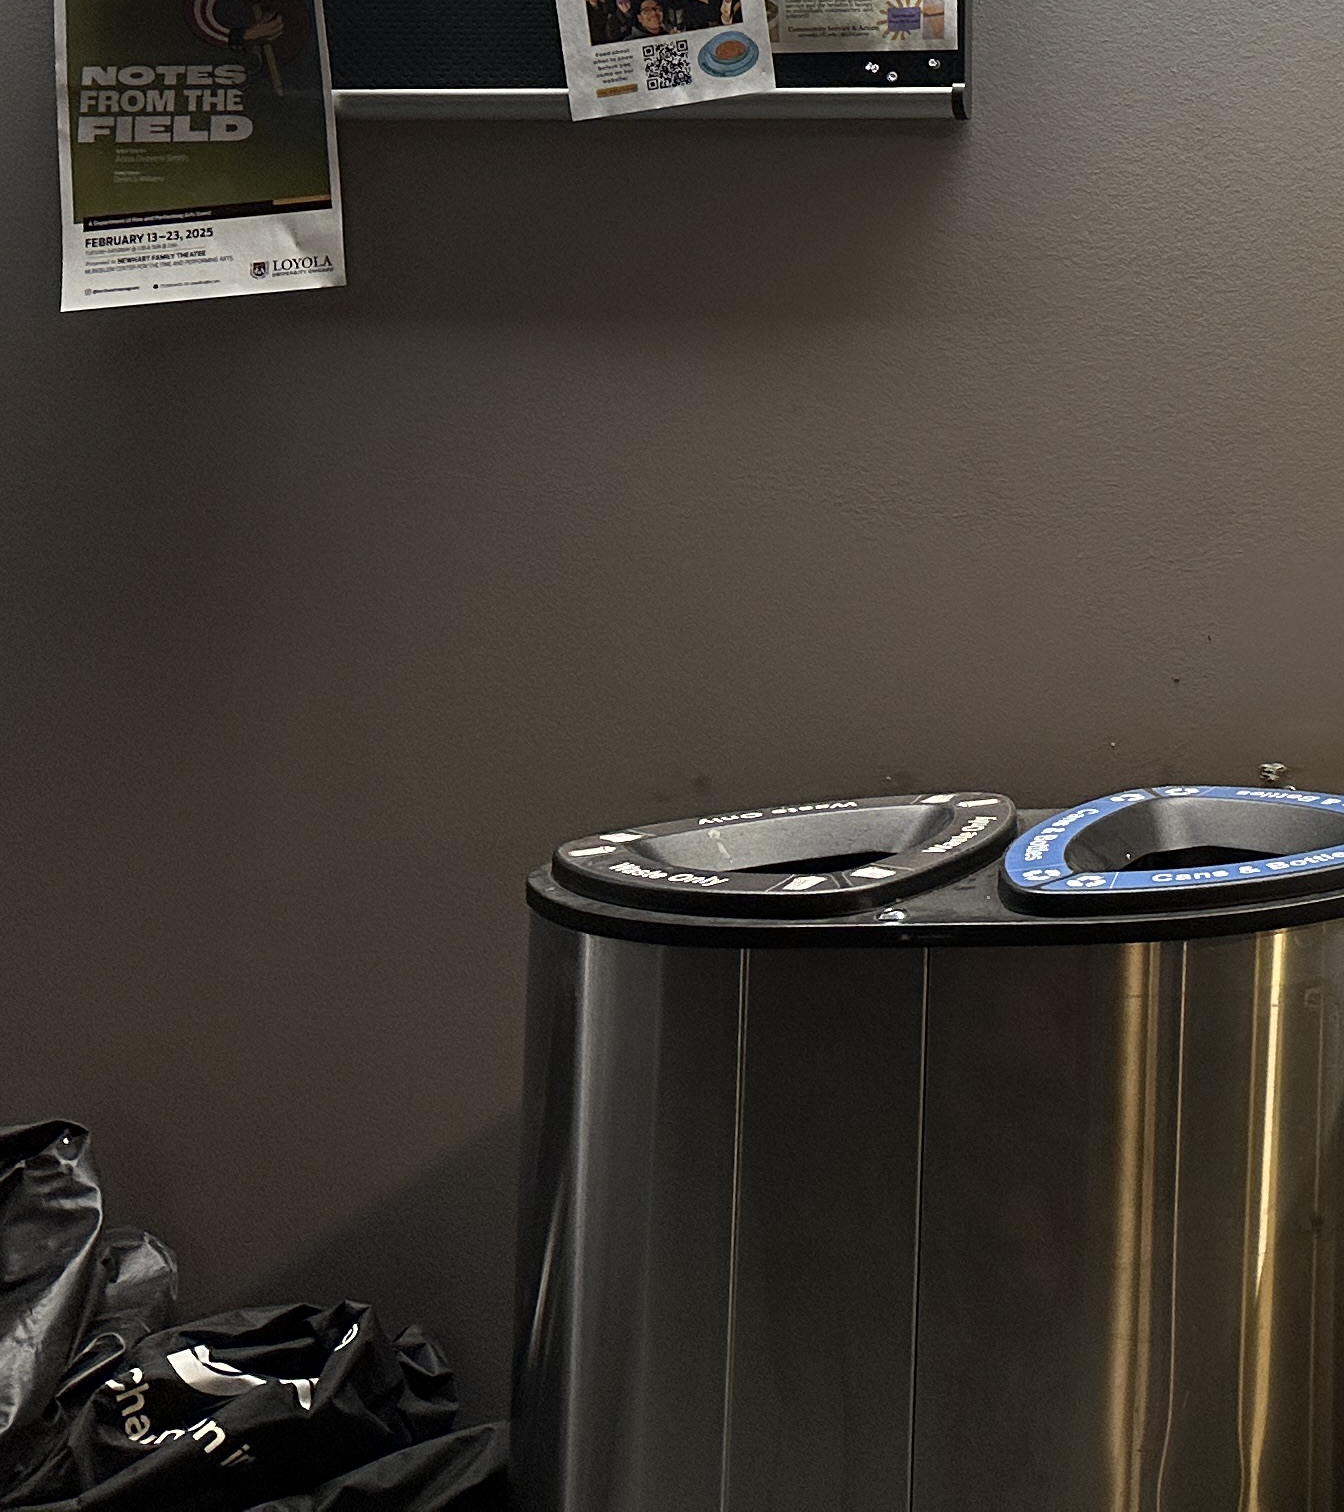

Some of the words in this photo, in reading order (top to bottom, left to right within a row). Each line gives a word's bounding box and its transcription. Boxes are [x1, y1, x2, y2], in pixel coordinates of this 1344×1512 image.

[81, 65, 247, 86] NOTES
[80, 90, 175, 113] FROM
[184, 90, 244, 111] THE
[77, 115, 253, 143] FIELD
[85, 234, 144, 248] FEBRUARY
[186, 228, 213, 238] 2025
[272, 256, 332, 271] LOYOLA
[609, 862, 669, 883] Waste
[668, 872, 729, 887] Only
[1152, 870, 1228, 884] Cans
[1238, 865, 1260, 875] &
